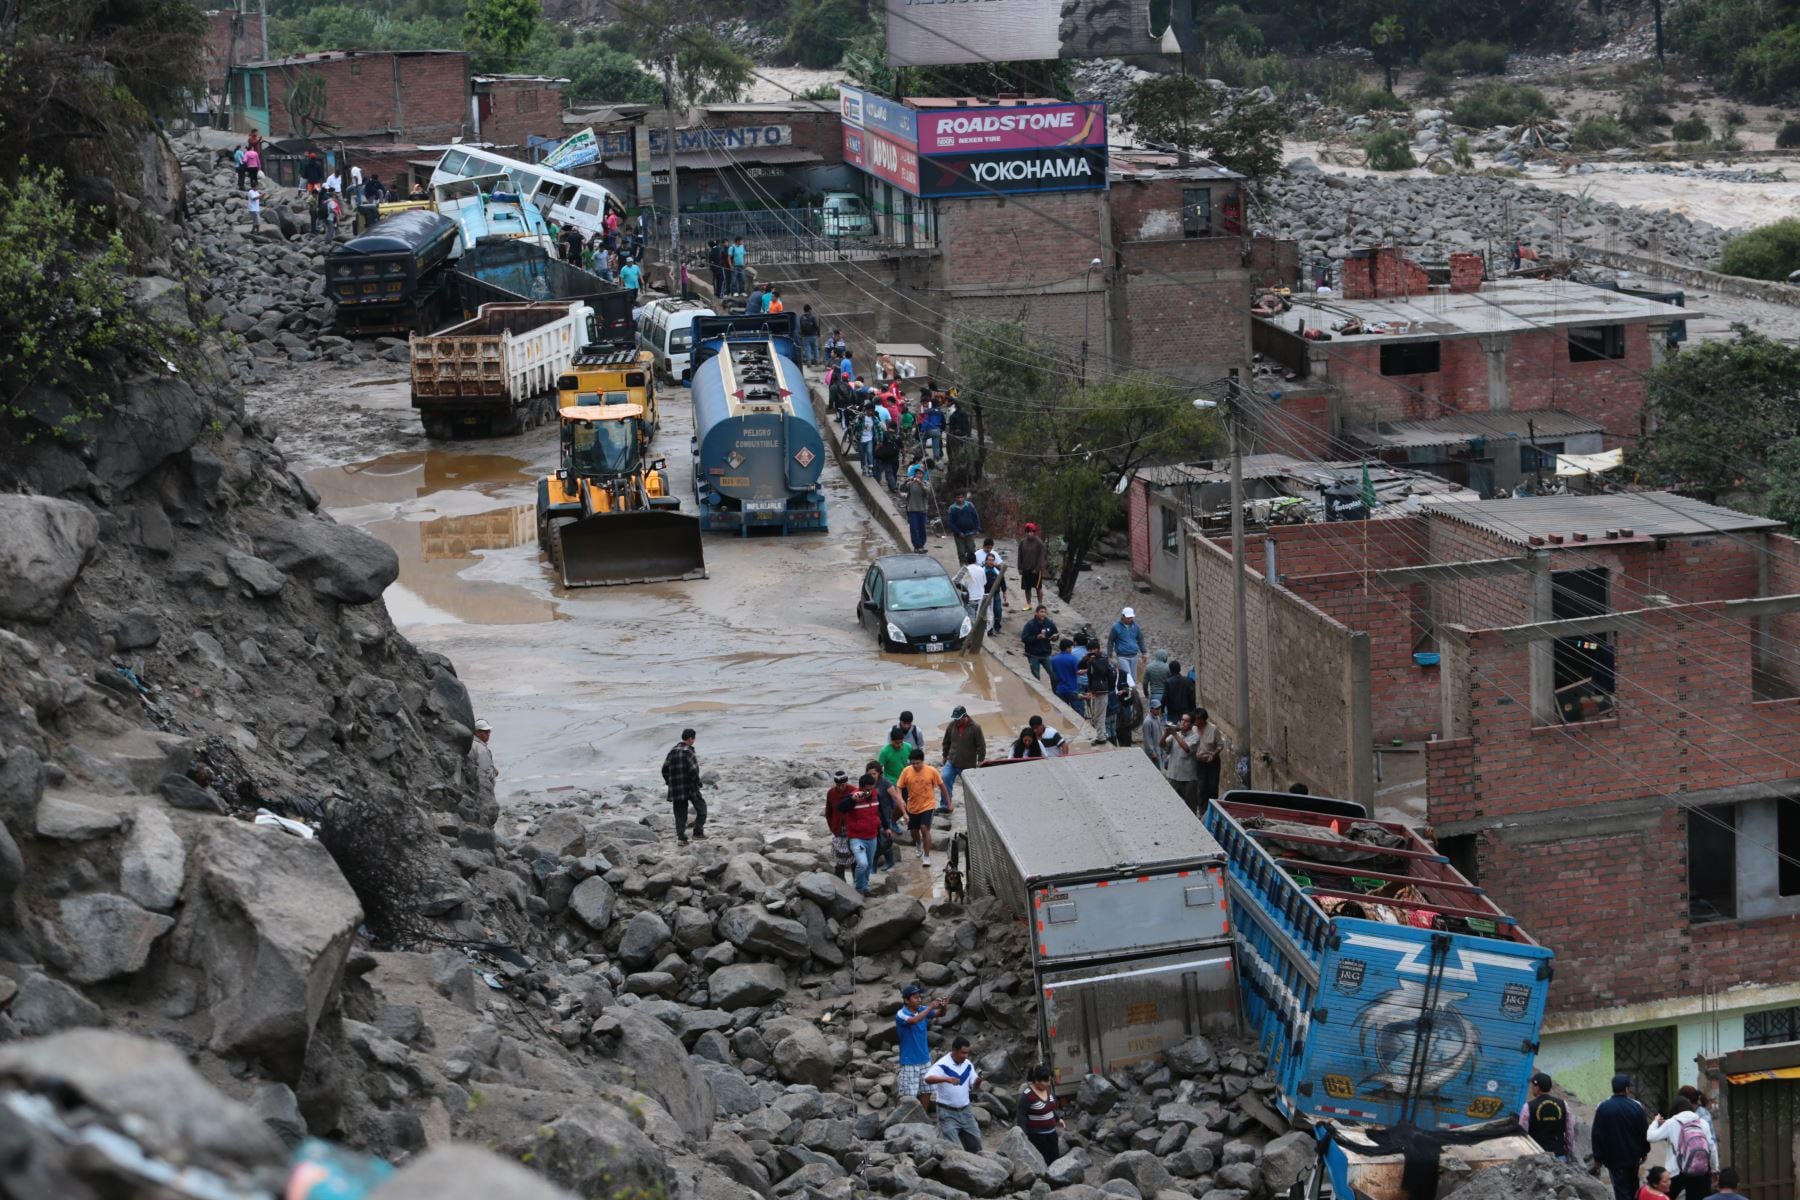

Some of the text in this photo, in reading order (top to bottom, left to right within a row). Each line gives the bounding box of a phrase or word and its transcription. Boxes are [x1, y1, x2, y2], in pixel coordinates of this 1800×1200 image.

[936, 112, 1075, 134] ROADSTONE
[970, 157, 1092, 182] YOKOHAMA
[743, 429, 772, 437] PELIGRO
[735, 440, 779, 448] COMBUSTIBLE
[1340, 970, 1361, 980] J&G
[1504, 995, 1525, 1005] J&G
